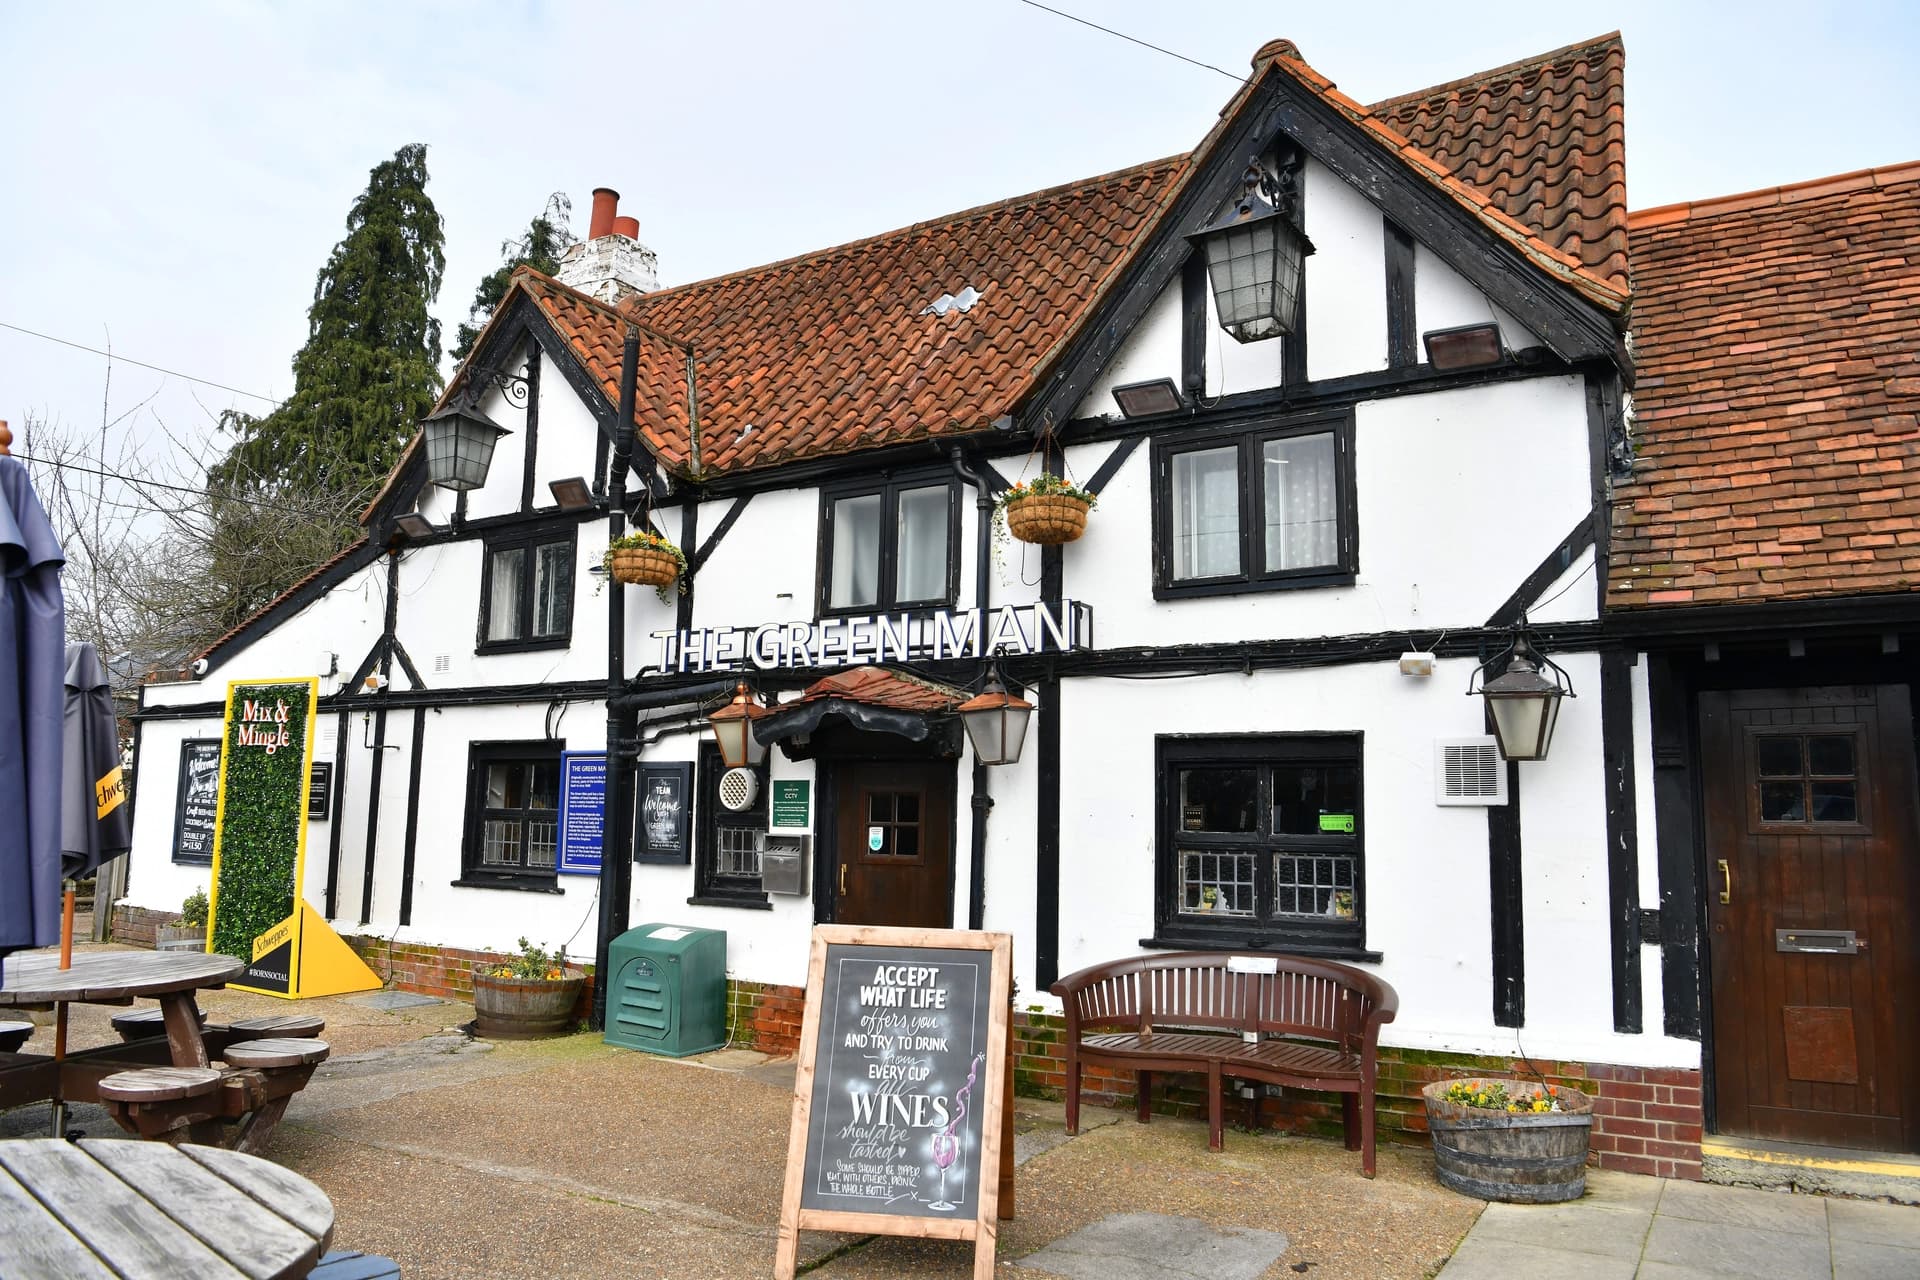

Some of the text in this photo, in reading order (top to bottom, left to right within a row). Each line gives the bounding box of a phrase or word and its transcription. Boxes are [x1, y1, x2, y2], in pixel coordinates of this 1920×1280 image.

[653, 599, 1073, 673] THE GREEN MAN
[241, 697, 290, 723] Mix &
[237, 723, 290, 755] Mingle
[97, 778, 124, 808] chwe
[656, 786, 671, 795] TEAM
[645, 794, 681, 822] Welcome
[256, 925, 289, 954] Schweppes
[249, 968, 289, 982] #BORNSOCIAL
[874, 965, 939, 987] ACCEPT
[861, 986, 946, 1009] WHAT LIFE
[860, 1008, 938, 1036] offers you
[845, 1033, 949, 1052] AND TRY TO DRINK
[869, 1064, 930, 1081] EVERY CUP
[877, 1052, 926, 1071] from
[876, 1080, 918, 1097] all
[850, 1092, 950, 1128] WINES
[836, 1120, 911, 1145] should be
[849, 1139, 898, 1165] tasted
[837, 1159, 855, 1173] SOME
[858, 1162, 884, 1175] SHOULD
[886, 1164, 895, 1176] BE
[842, 1183, 863, 1197] WHOLE
[866, 1185, 894, 1198] BOTTLE
[843, 1173, 861, 1183] WITH
[891, 1176, 917, 1187] DRINK
